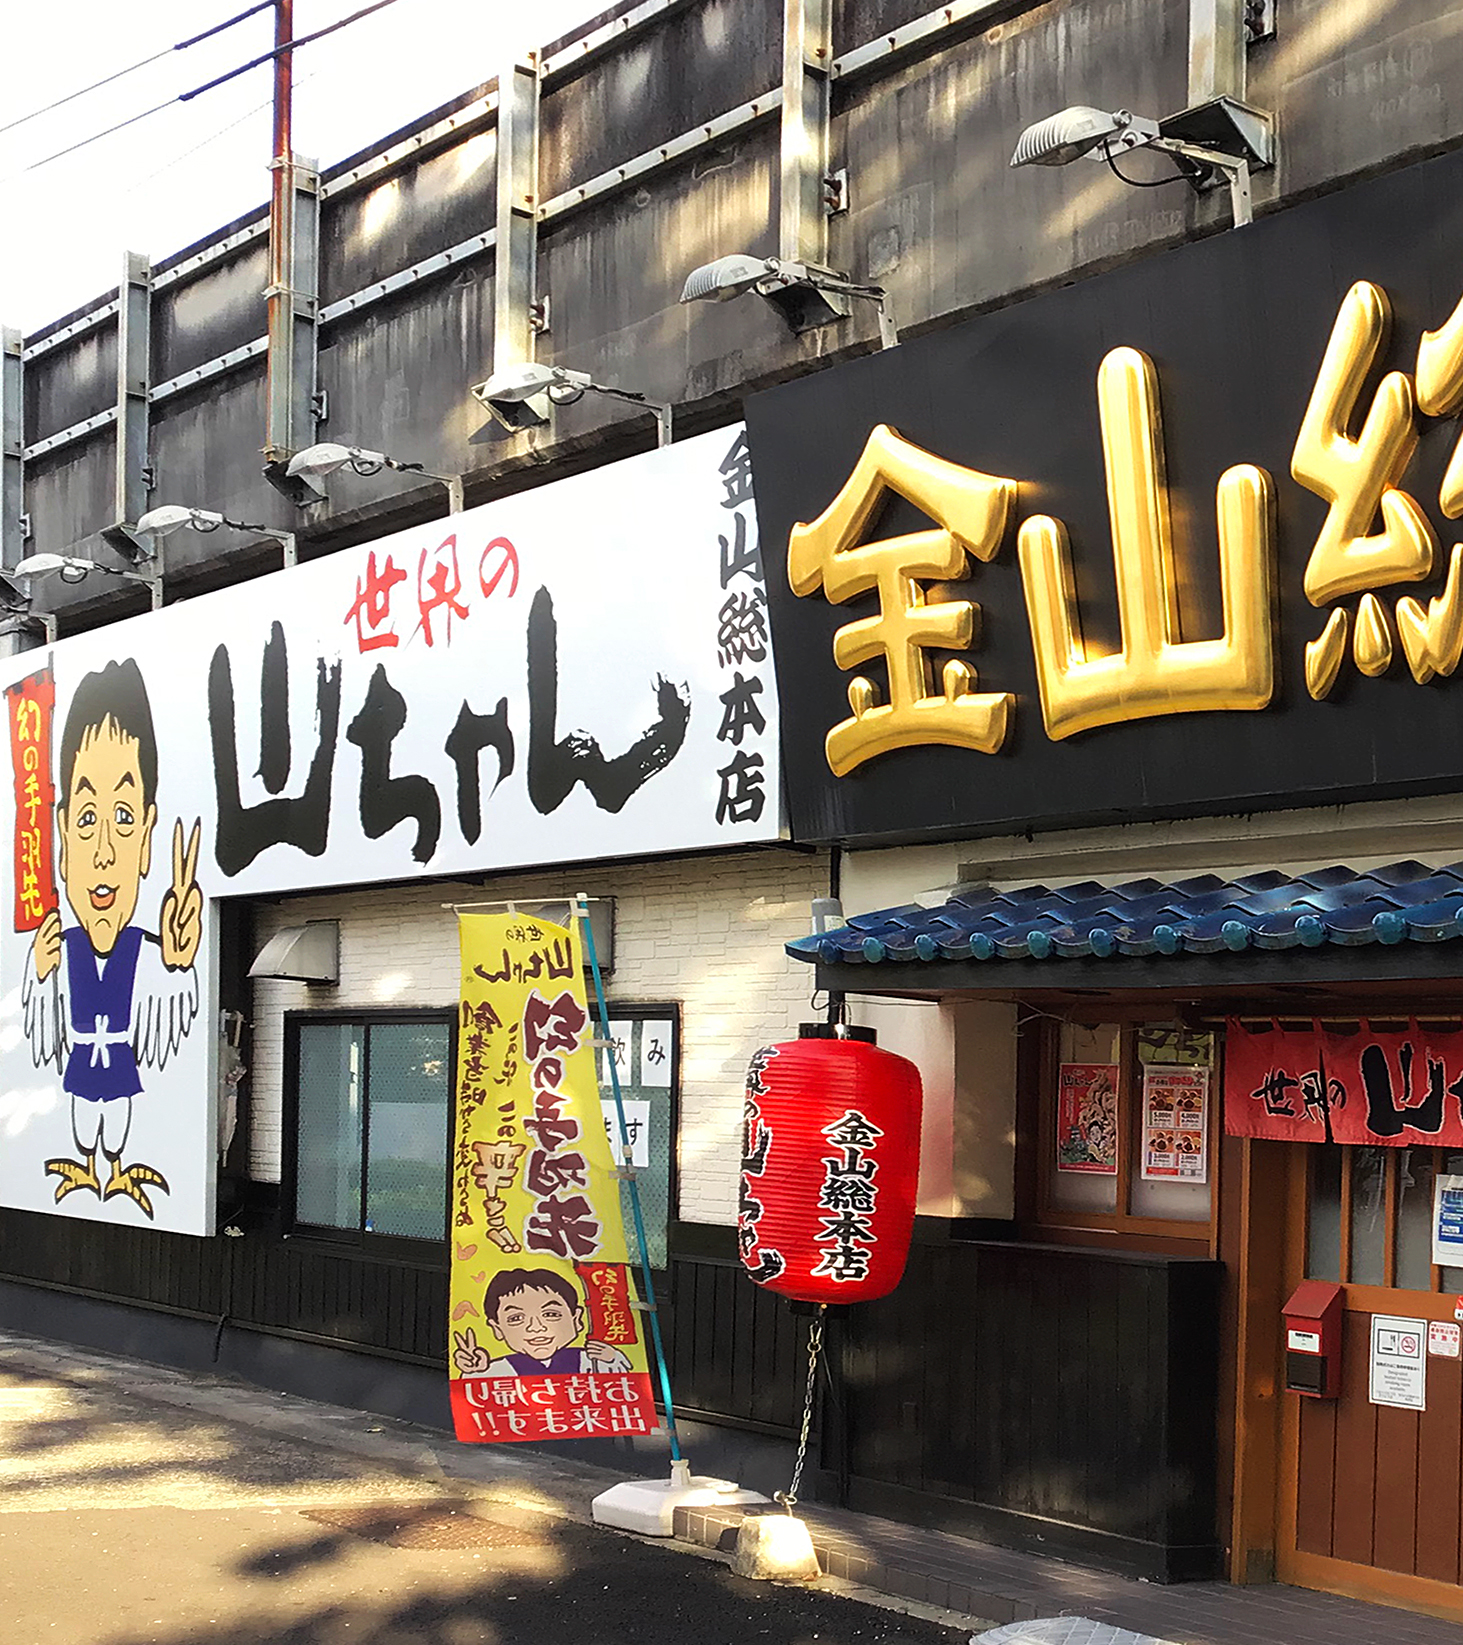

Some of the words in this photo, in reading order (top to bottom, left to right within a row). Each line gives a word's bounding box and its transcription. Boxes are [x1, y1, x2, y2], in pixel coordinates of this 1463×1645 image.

[344, 533, 520, 655] 世界の
[714, 430, 767, 826] 金山総本店
[15, 697, 44, 920] 幻の手羽先
[207, 584, 692, 878] 山ちゃん
[811, 1110, 884, 1282] 金山総本店
